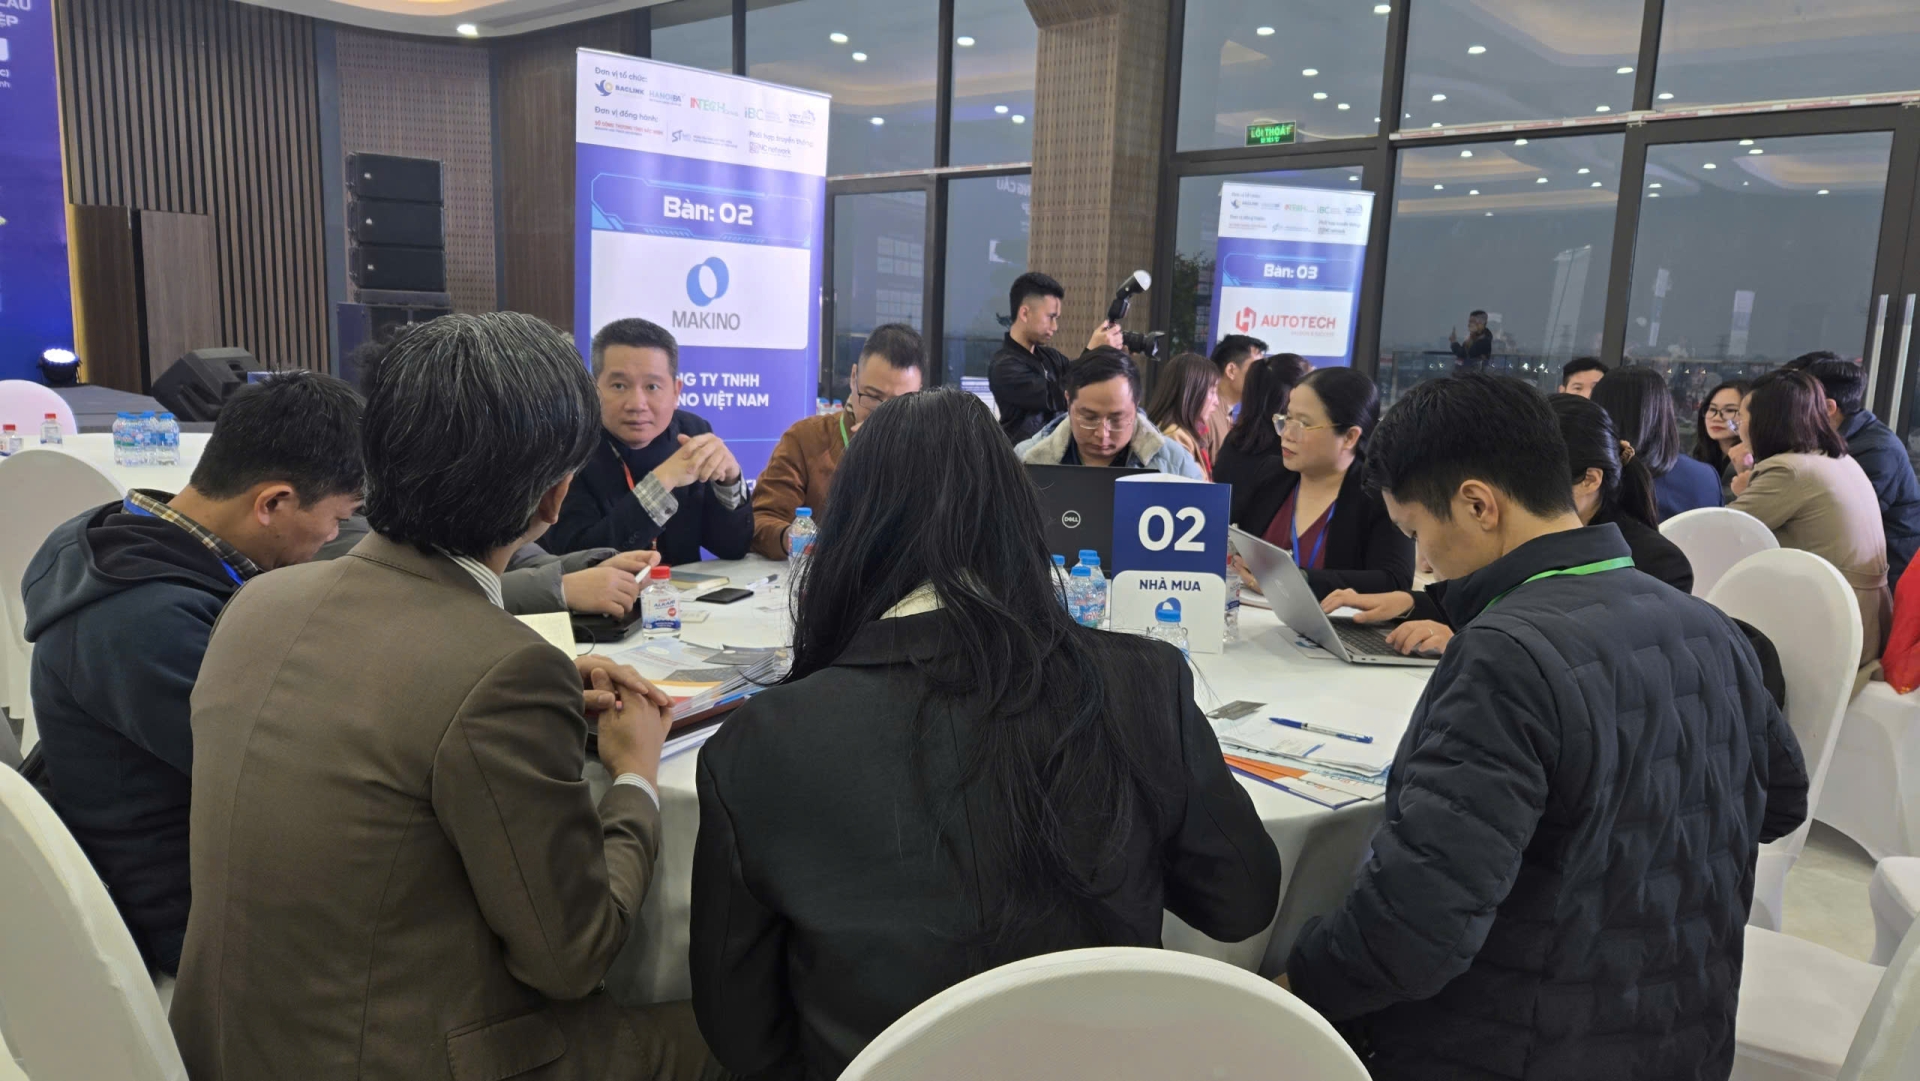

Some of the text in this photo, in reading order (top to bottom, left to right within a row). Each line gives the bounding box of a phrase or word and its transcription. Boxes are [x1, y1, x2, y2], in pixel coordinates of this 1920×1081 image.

[663, 195, 754, 226] Bàn: 02
[1263, 263, 1318, 279] Bàn: 03
[672, 310, 741, 331] MAKINO
[1261, 314, 1337, 329] AUTOTECH
[699, 373, 718, 387] TY
[721, 373, 760, 388] TNHH
[702, 390, 734, 411] VIỆT
[737, 393, 769, 407] NAM
[1138, 505, 1206, 552] 02
[1139, 577, 1201, 592] NHÀ MUA
